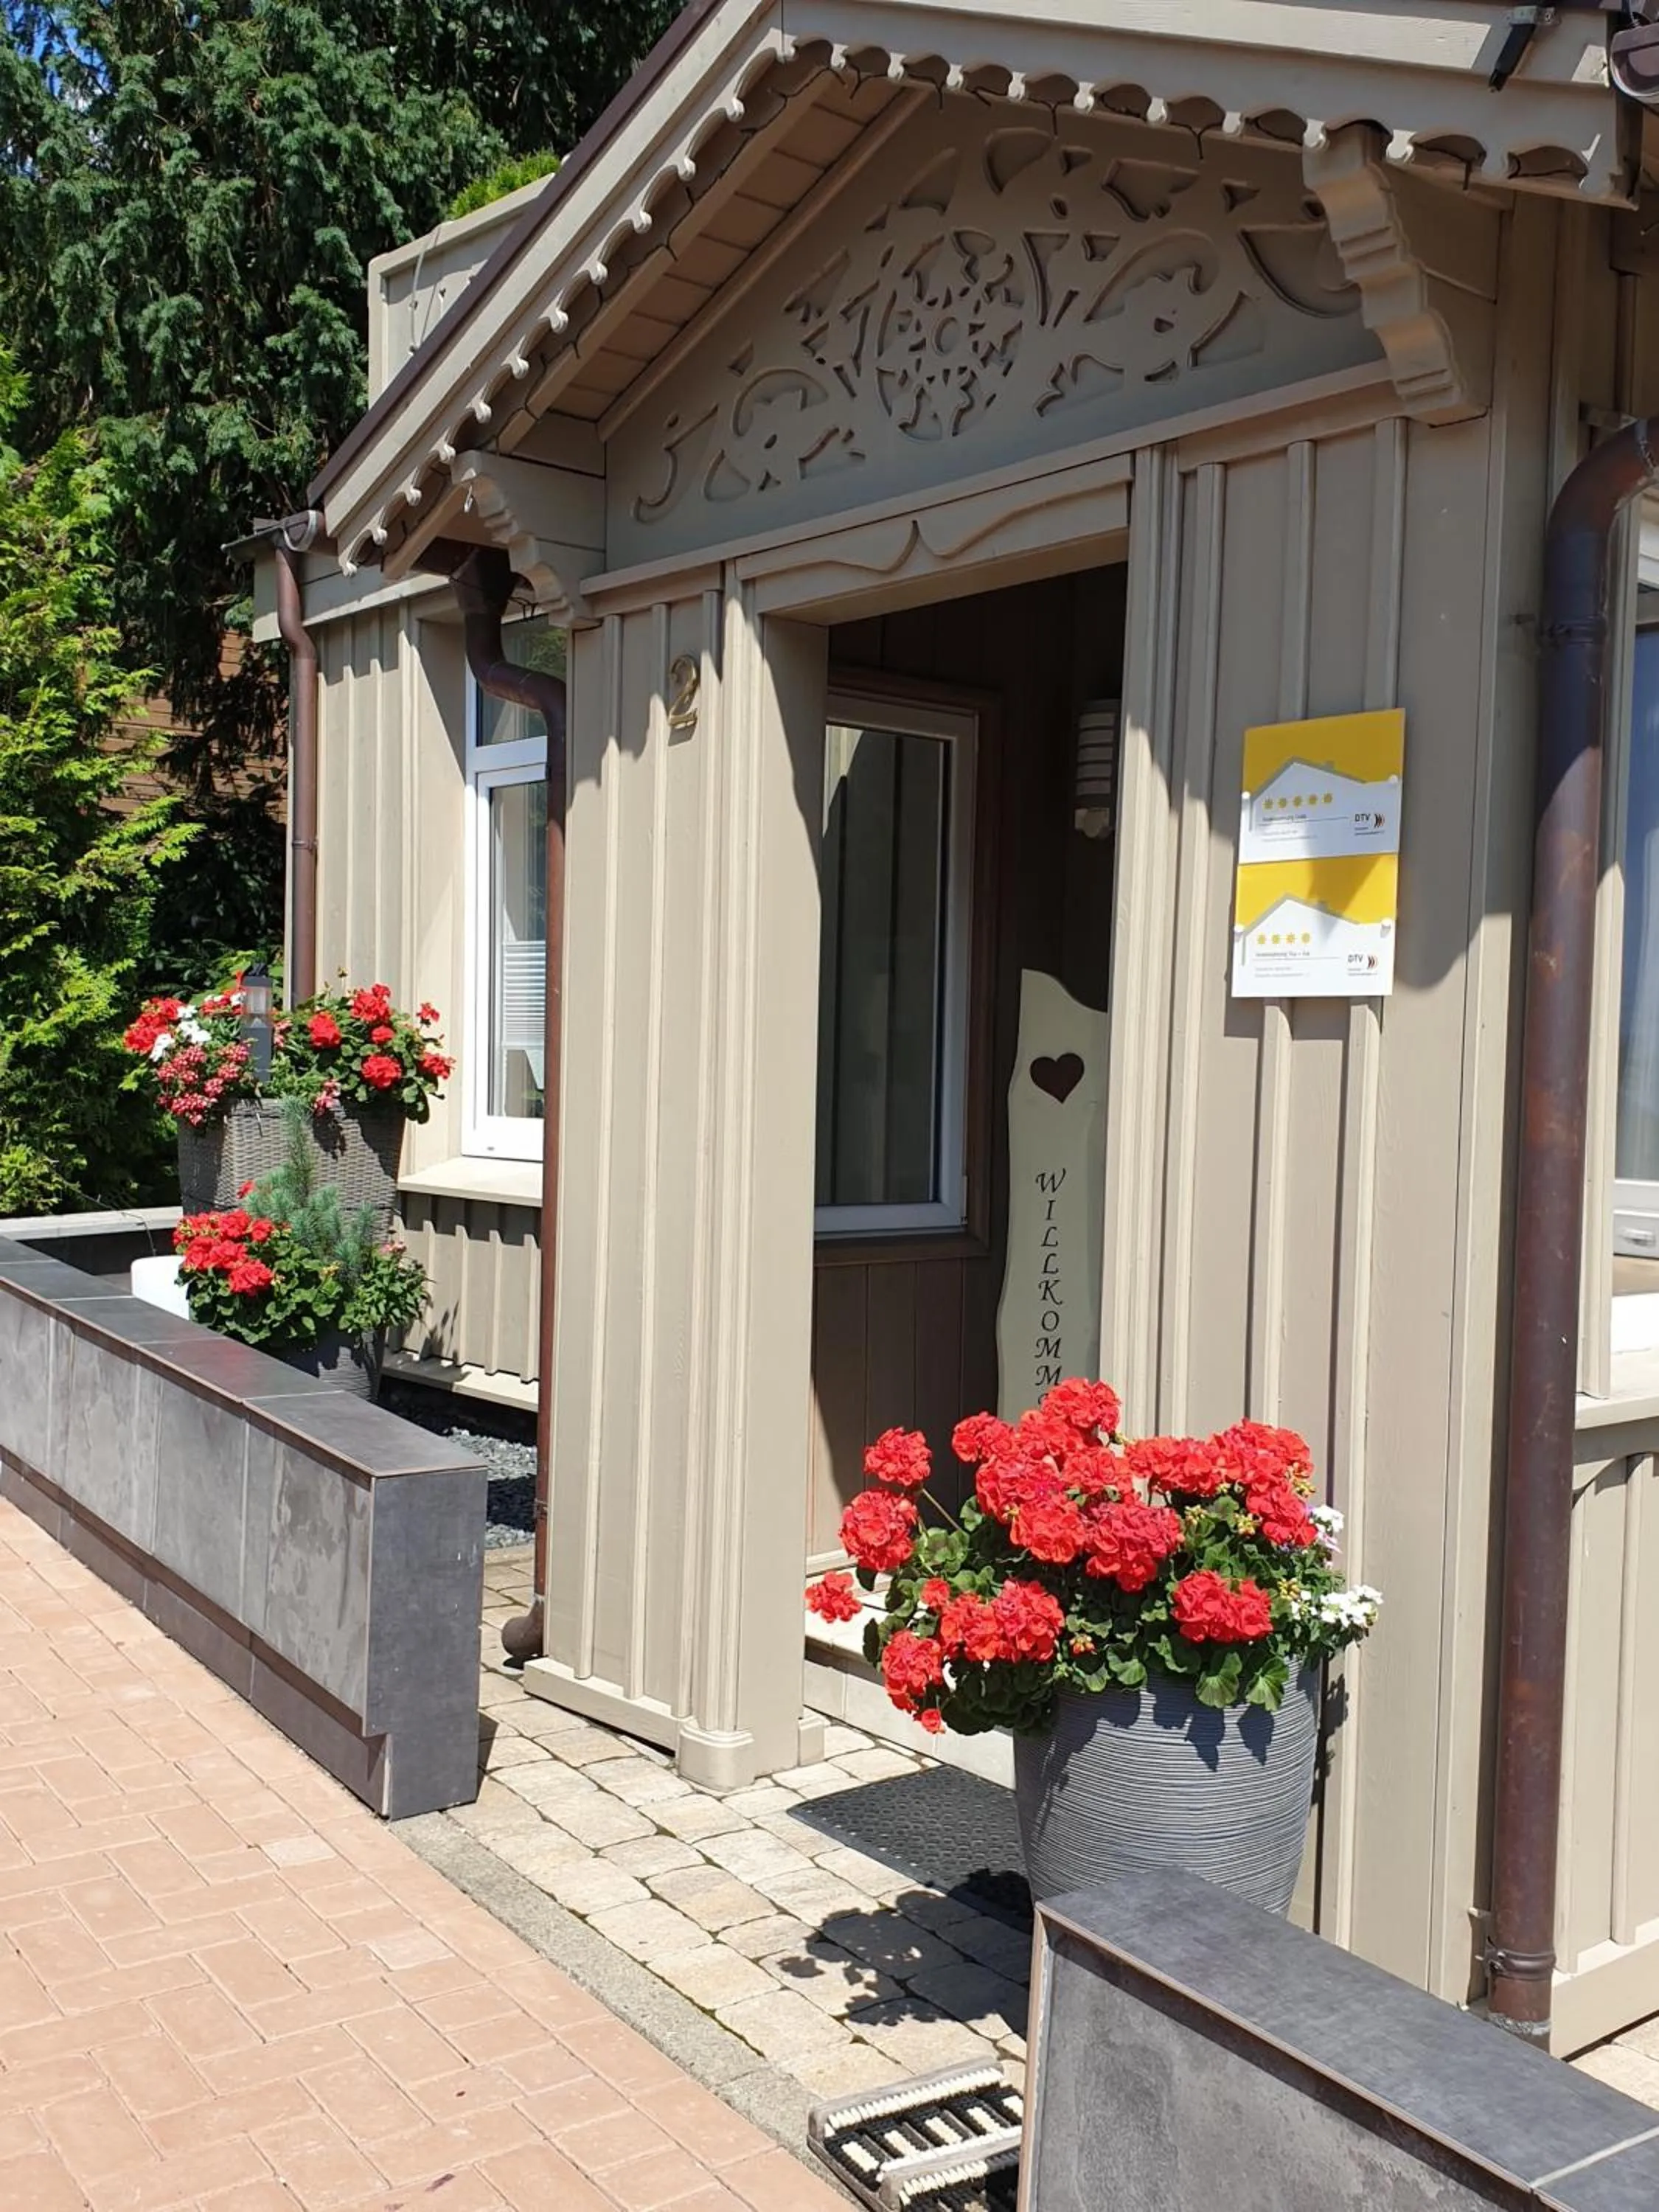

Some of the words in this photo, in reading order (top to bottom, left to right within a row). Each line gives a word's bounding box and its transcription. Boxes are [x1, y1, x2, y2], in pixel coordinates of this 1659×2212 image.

[668, 654, 700, 730] 2
[1354, 813, 1371, 823] DTV
[1348, 953, 1364, 963] DTV
